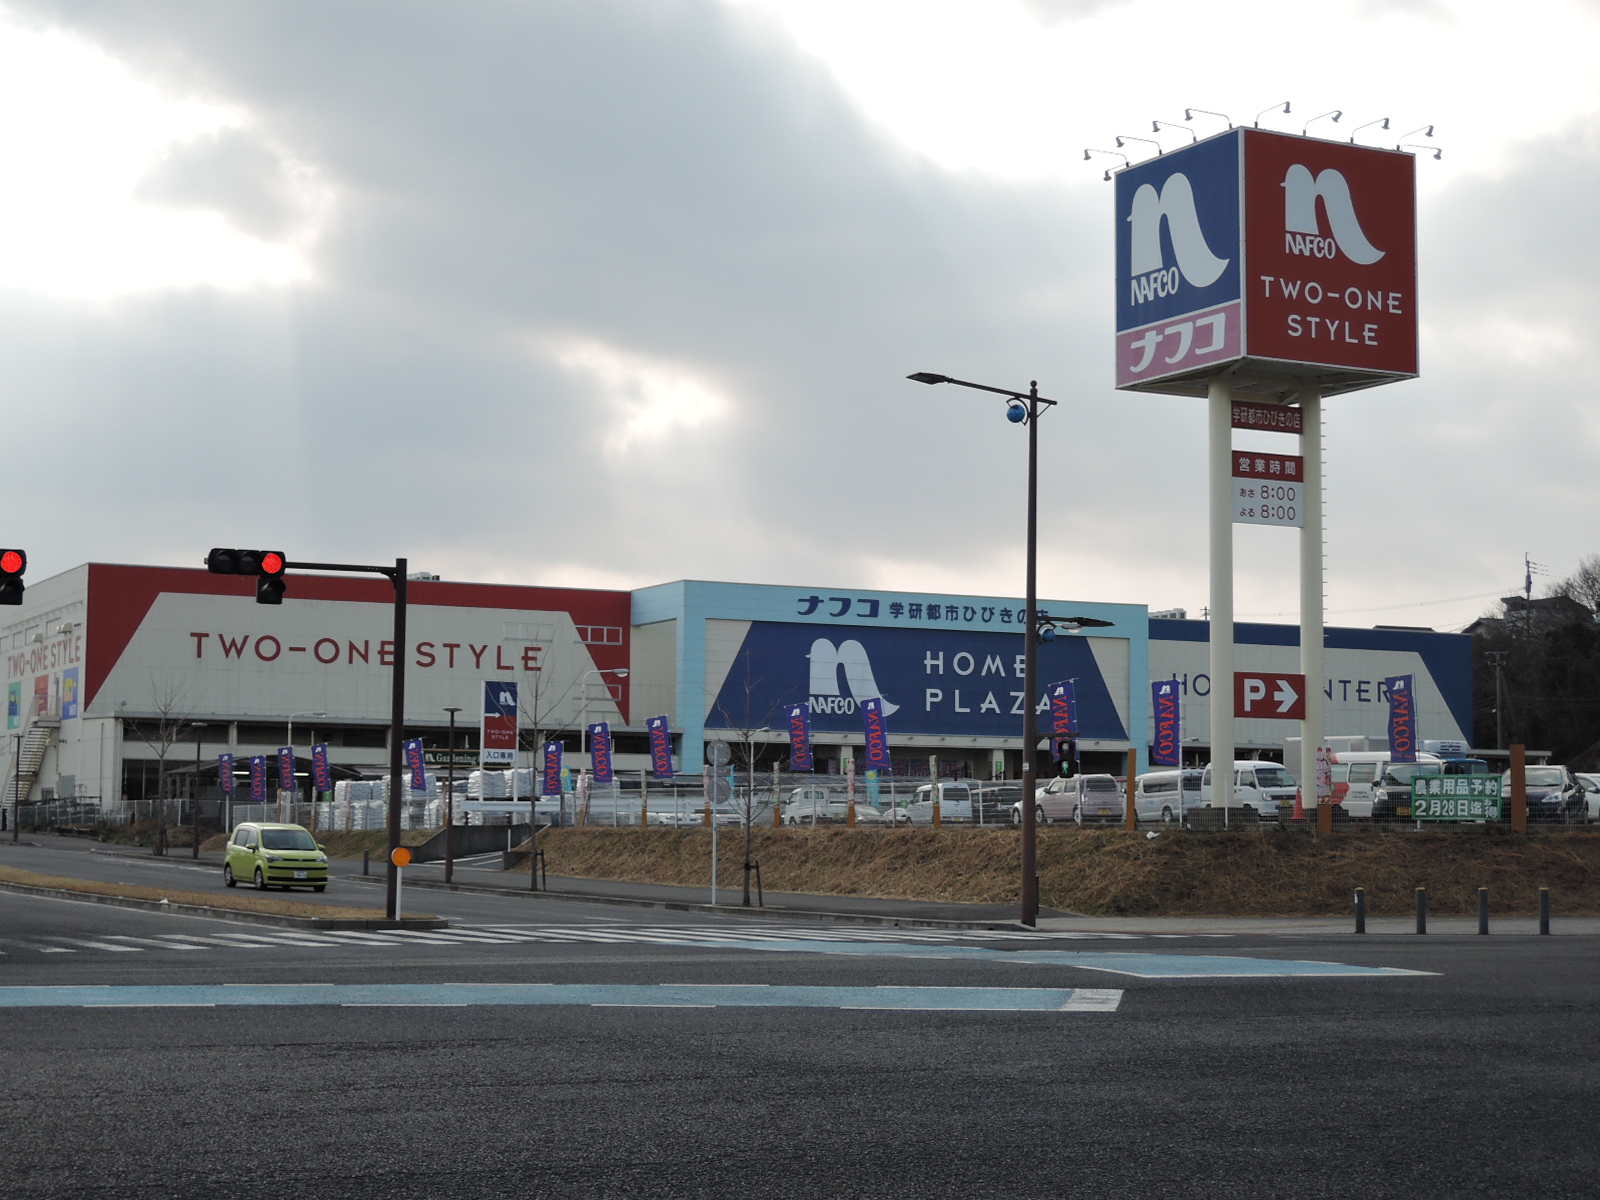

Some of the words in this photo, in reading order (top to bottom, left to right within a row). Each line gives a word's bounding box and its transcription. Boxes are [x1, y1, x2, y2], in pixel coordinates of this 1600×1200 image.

[1285, 232, 1336, 259] NAFCO
[1131, 266, 1179, 306] NAFCO
[1260, 275, 1402, 314] TWO-ONE
[1130, 312, 1226, 373] ナフコ
[1287, 315, 1378, 346] STYLE
[1232, 407, 1300, 429] 学研都市ひびきの店
[1238, 457, 1296, 476] 営業時間
[1239, 487, 1255, 498] あさ
[1260, 485, 1296, 501] 8:00
[1239, 507, 1255, 518] よる
[1260, 504, 1296, 520] 8:00
[797, 595, 880, 618] ナフコ
[51, 635, 81, 669] STYLE
[190, 632, 395, 666] TWO-ONE
[415, 641, 542, 671] STYLE
[924, 651, 1026, 678] HOME
[809, 696, 855, 715] NAFCO
[925, 688, 1050, 715] PLAZA
[1243, 678, 1266, 712] P
[485, 751, 514, 760] 入口専用
[1415, 779, 1498, 795] 農業用品予約
